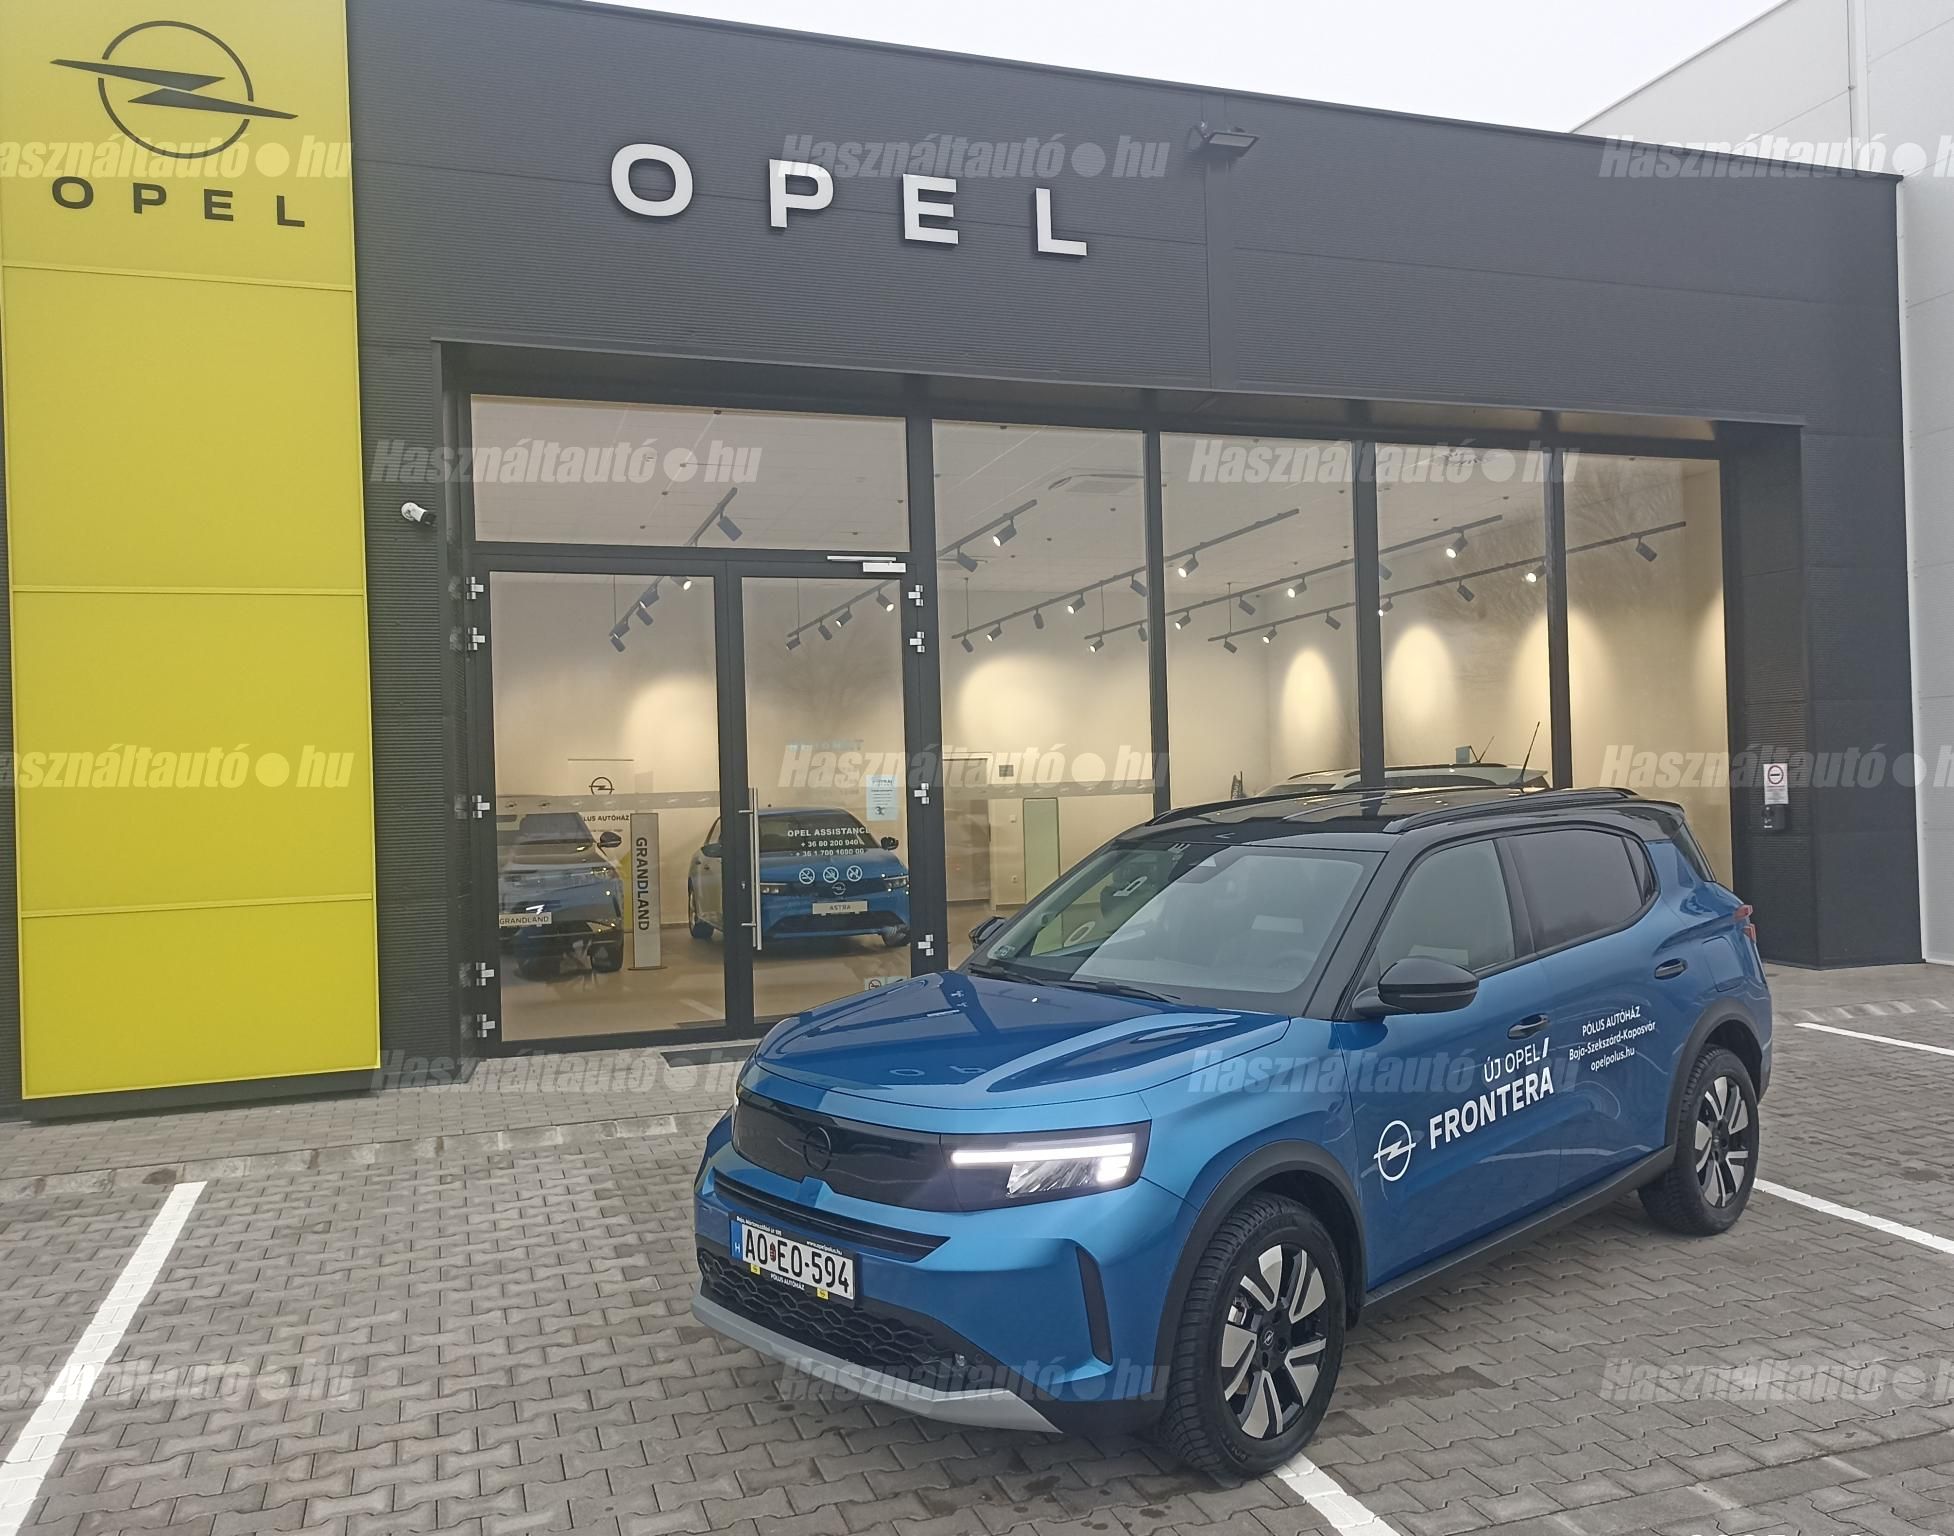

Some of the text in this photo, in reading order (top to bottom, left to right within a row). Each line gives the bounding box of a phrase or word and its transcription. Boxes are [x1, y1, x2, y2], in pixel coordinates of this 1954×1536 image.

[52, 176, 305, 228] OPEL
[611, 142, 1087, 257] OPEL
[787, 830, 811, 838] OPEL
[635, 837, 650, 931] GRANDLAND
[499, 915, 549, 925] GRANDLAND
[1582, 1005, 1641, 1037] PÓLUS AUTÓHÁZ
[1483, 1056, 1501, 1083] ÚJ
[1590, 1046, 1635, 1072] opelpolus.hu
[1429, 1066, 1554, 1150] FRONTERA
[734, 1242, 741, 1254] H
